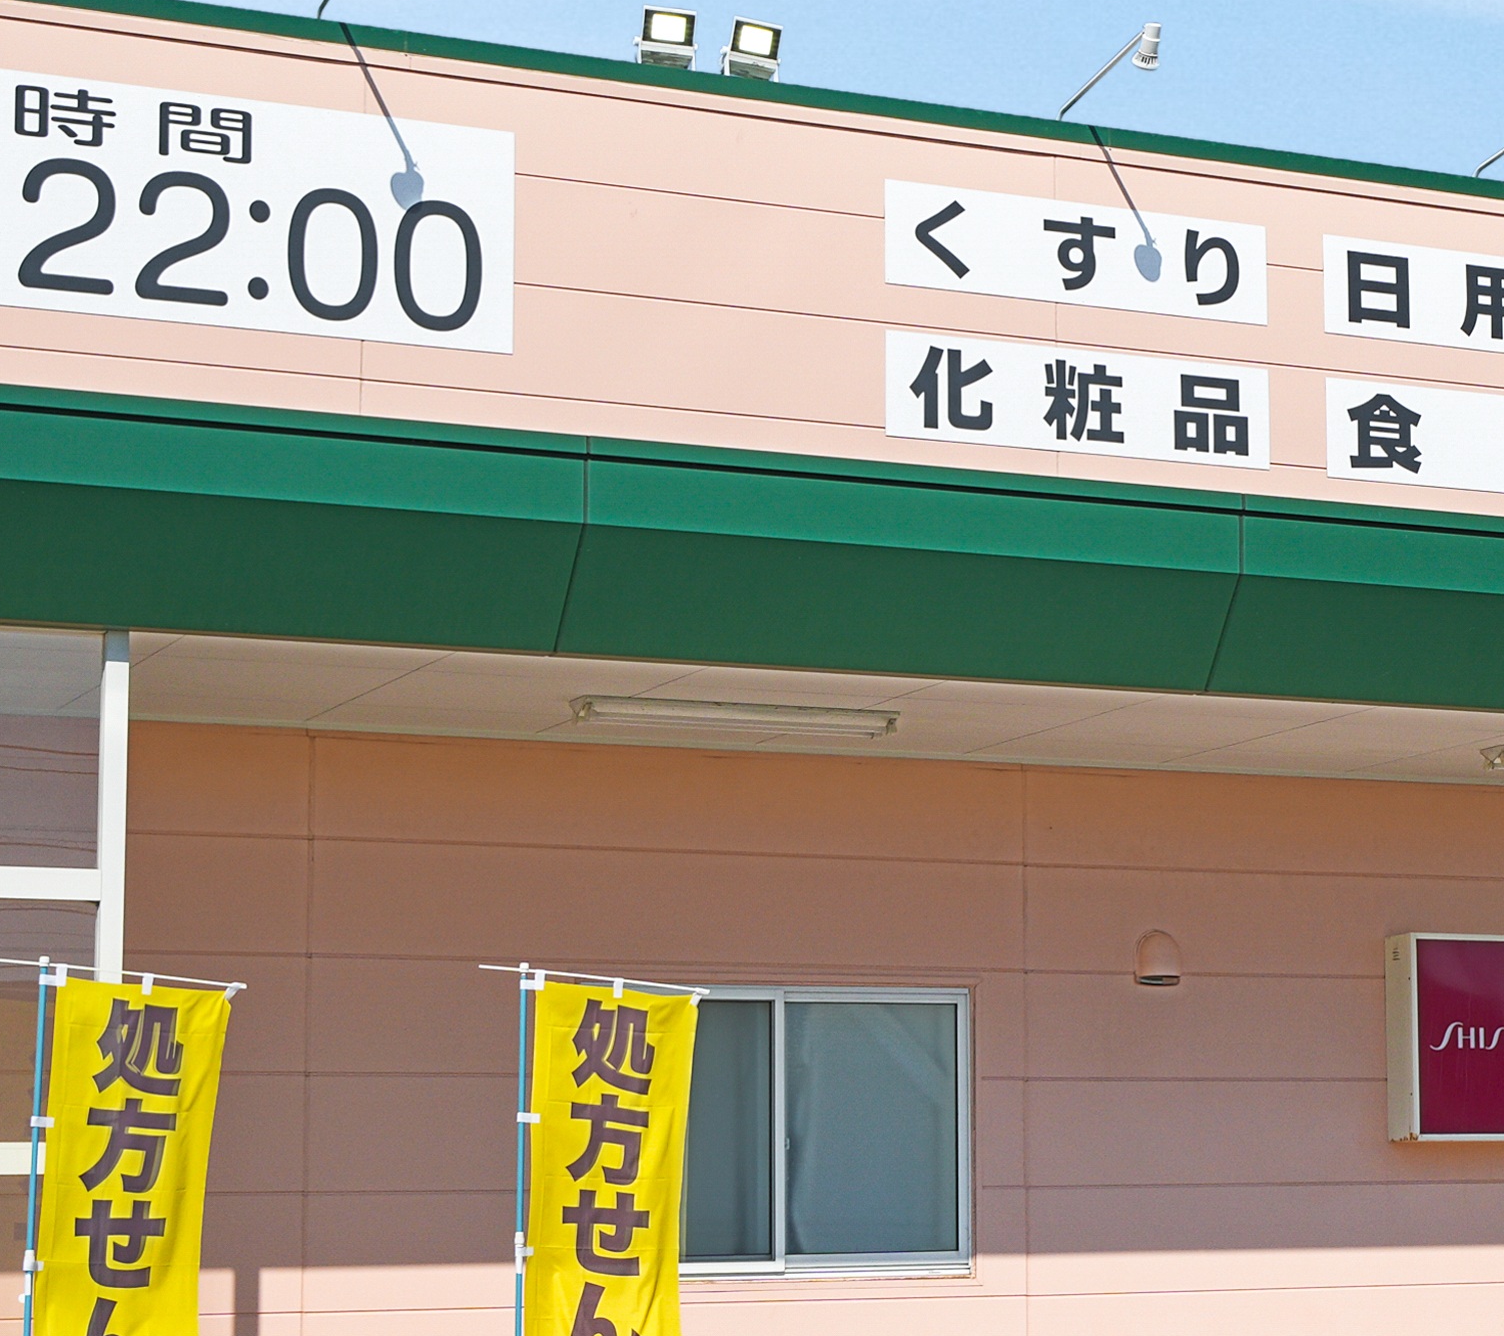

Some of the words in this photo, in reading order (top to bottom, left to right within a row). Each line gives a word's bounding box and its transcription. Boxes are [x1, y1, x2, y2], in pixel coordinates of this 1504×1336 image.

[911, 198, 1242, 307] くすり
[909, 344, 1250, 457] 化粧品
